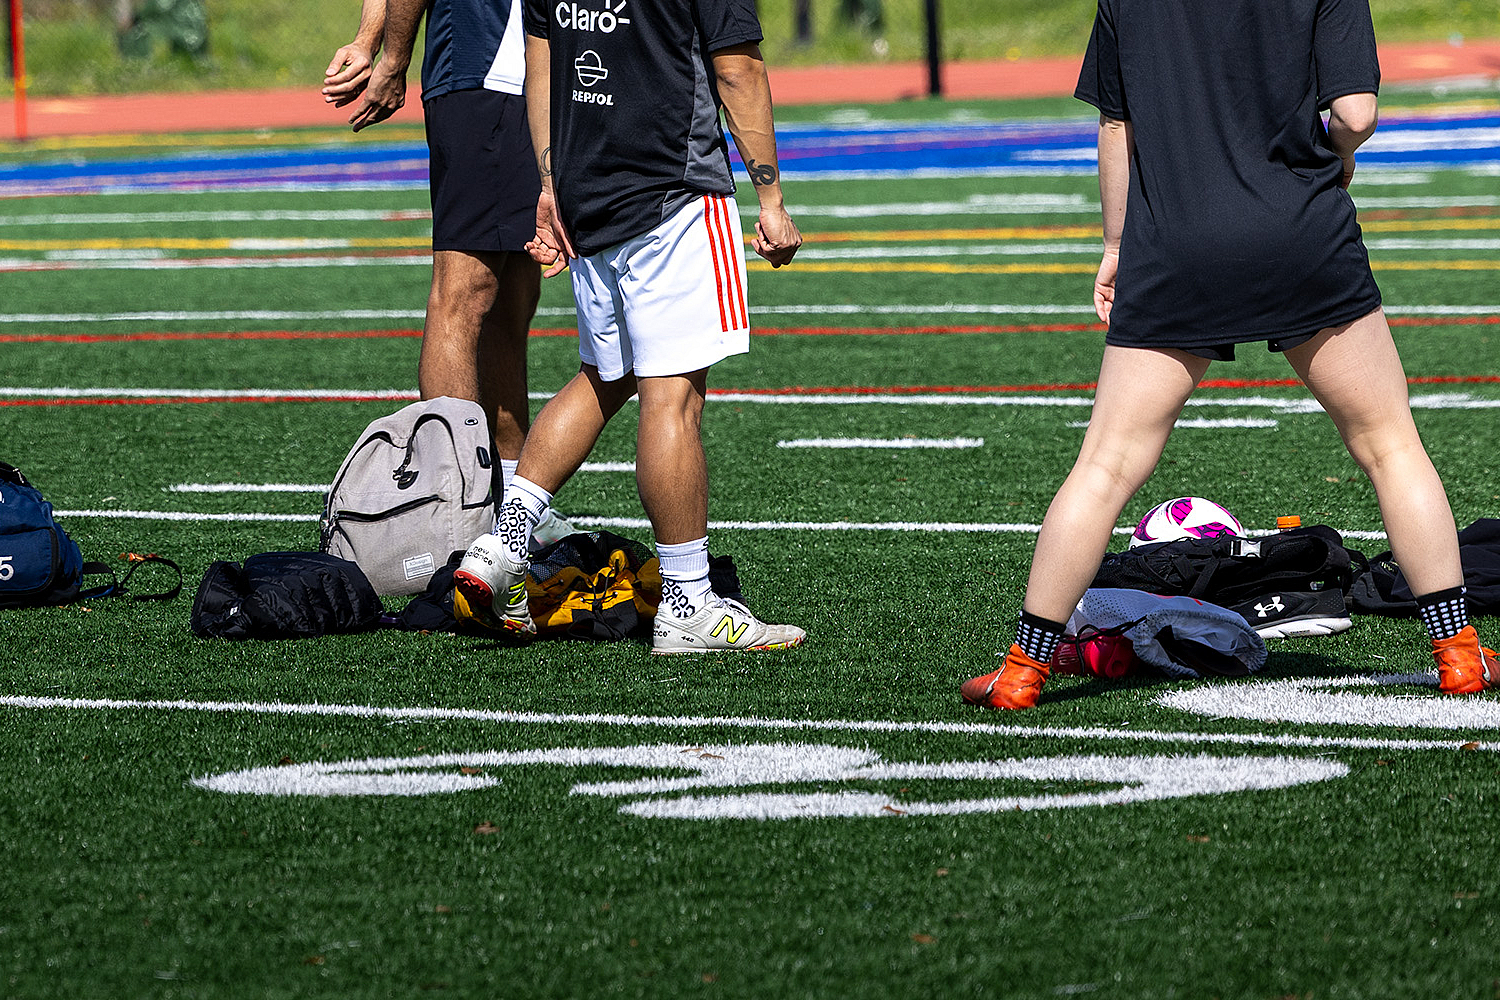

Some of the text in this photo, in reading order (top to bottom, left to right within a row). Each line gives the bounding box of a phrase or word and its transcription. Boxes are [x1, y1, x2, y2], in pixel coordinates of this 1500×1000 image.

[555, 0, 618, 33] Claro
[572, 89, 614, 106] REPSOL
[710, 614, 750, 644] N
